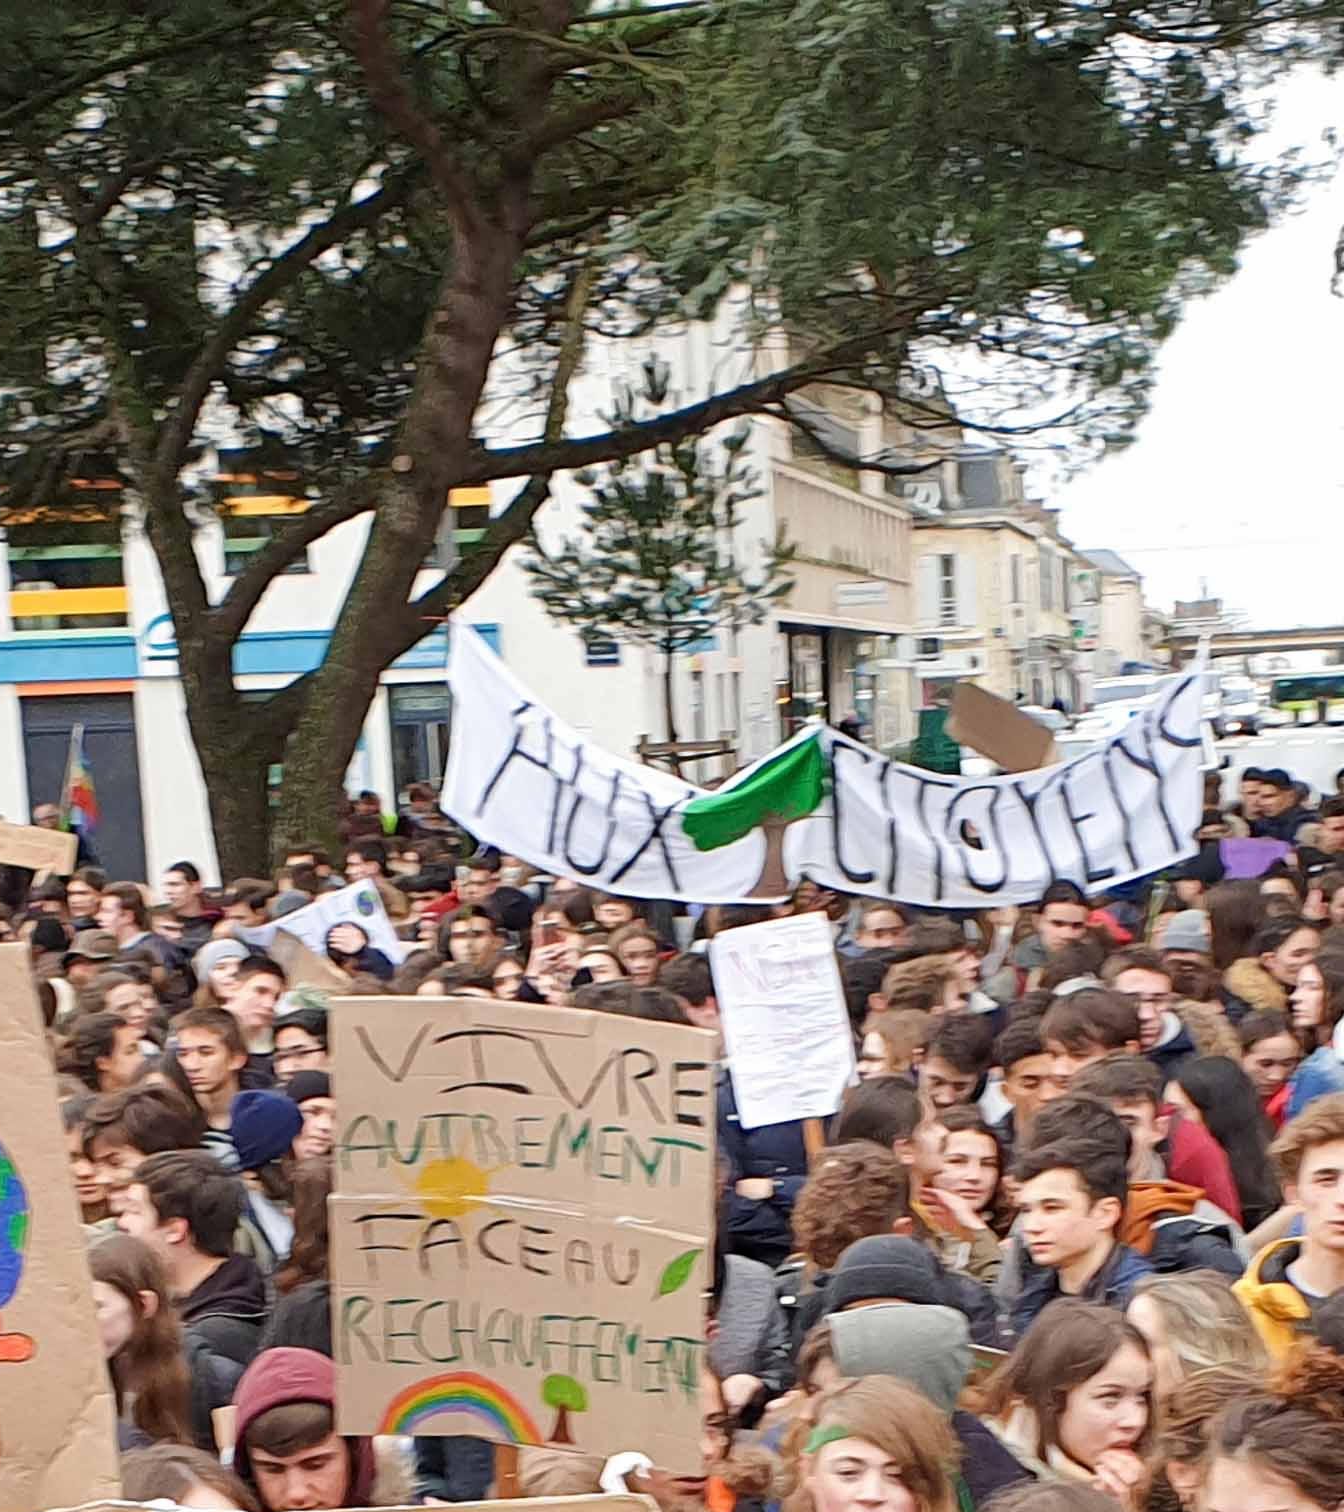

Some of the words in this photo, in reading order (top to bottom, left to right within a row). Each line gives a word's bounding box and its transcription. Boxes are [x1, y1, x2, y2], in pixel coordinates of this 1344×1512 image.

[474, 700, 696, 892] AUX
[830, 674, 1203, 902] CITOYENS
[354, 1022, 709, 1128] VIVRE
[336, 1111, 708, 1187] AUTREMENT
[352, 1213, 556, 1281] FACE
[340, 1295, 708, 1400] RECHAUFFEMENT
